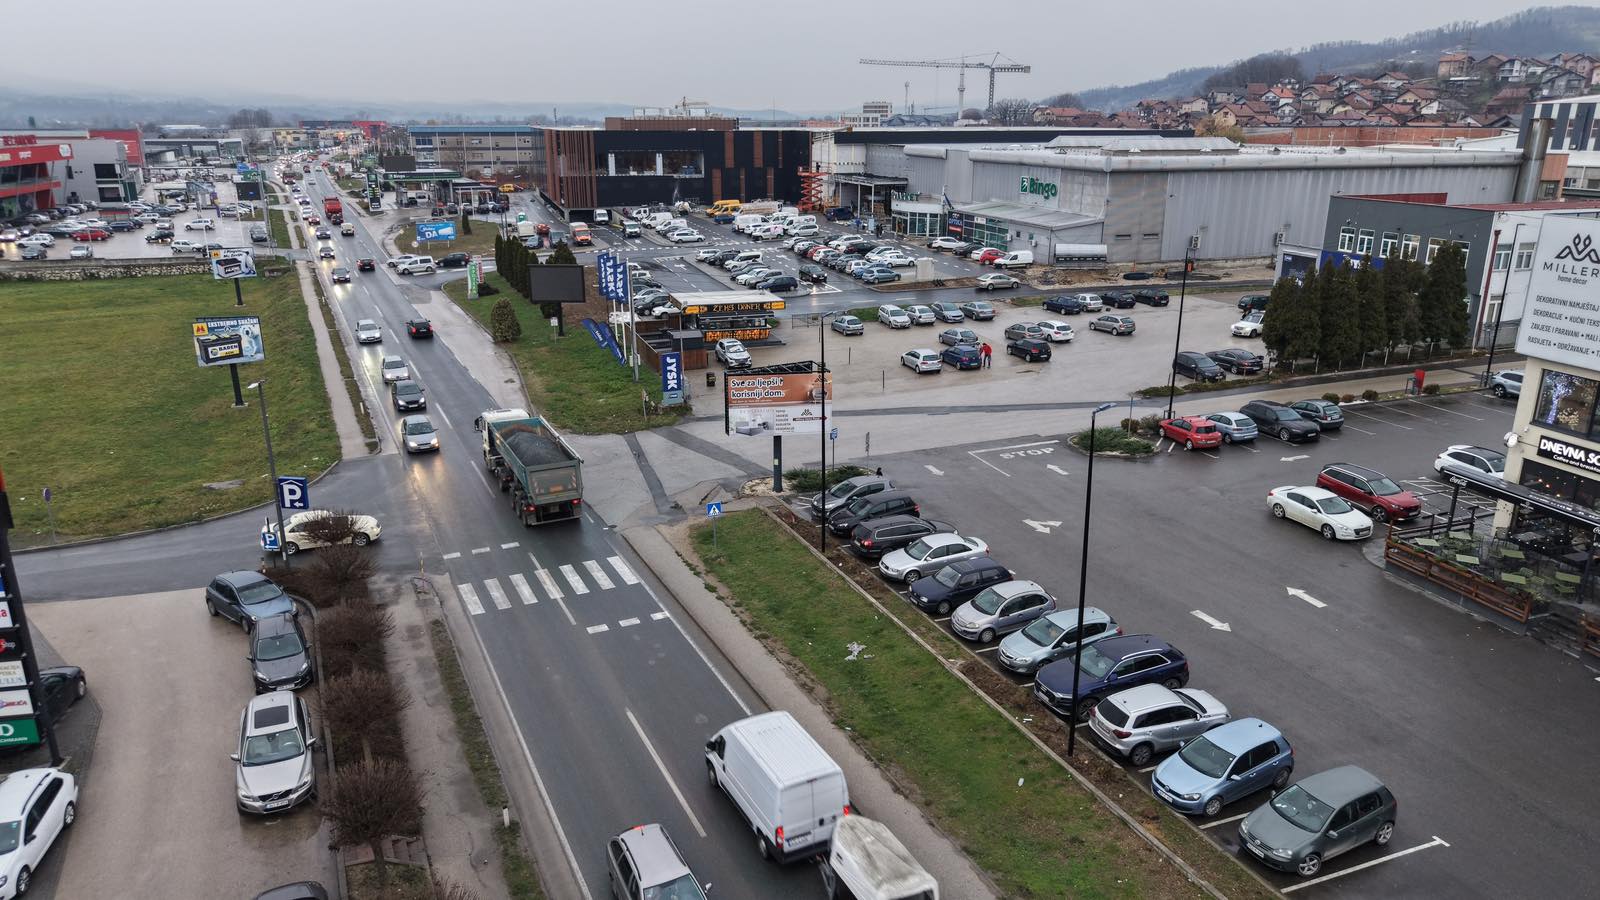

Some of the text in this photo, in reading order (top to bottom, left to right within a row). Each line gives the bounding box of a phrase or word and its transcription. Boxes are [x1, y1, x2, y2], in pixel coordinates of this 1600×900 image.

[1029, 177, 1058, 200] Bingo
[1543, 261, 1600, 278] MILLER
[1572, 277, 1588, 285] decor
[1536, 294, 1600, 312] DEKORATIVNI NAMJEŠTAJ
[1533, 308, 1563, 320] DEKORACIJE
[1531, 322, 1551, 333] ZAVJESE
[1555, 327, 1580, 338] PARAVANI
[1527, 335, 1552, 347] RASVJETA
[1557, 342, 1590, 355] ODRŽAVANJE
[666, 356, 678, 390] JYSK
[731, 379, 745, 387] Sve
[757, 377, 777, 389] ljepši
[731, 389, 784, 399] korisniji dom.
[1000, 447, 1054, 459] STOP
[1540, 438, 1586, 462] DNEVNA
[1553, 454, 1569, 463] Coffee
[283, 484, 302, 508] P
[265, 533, 275, 544] P
